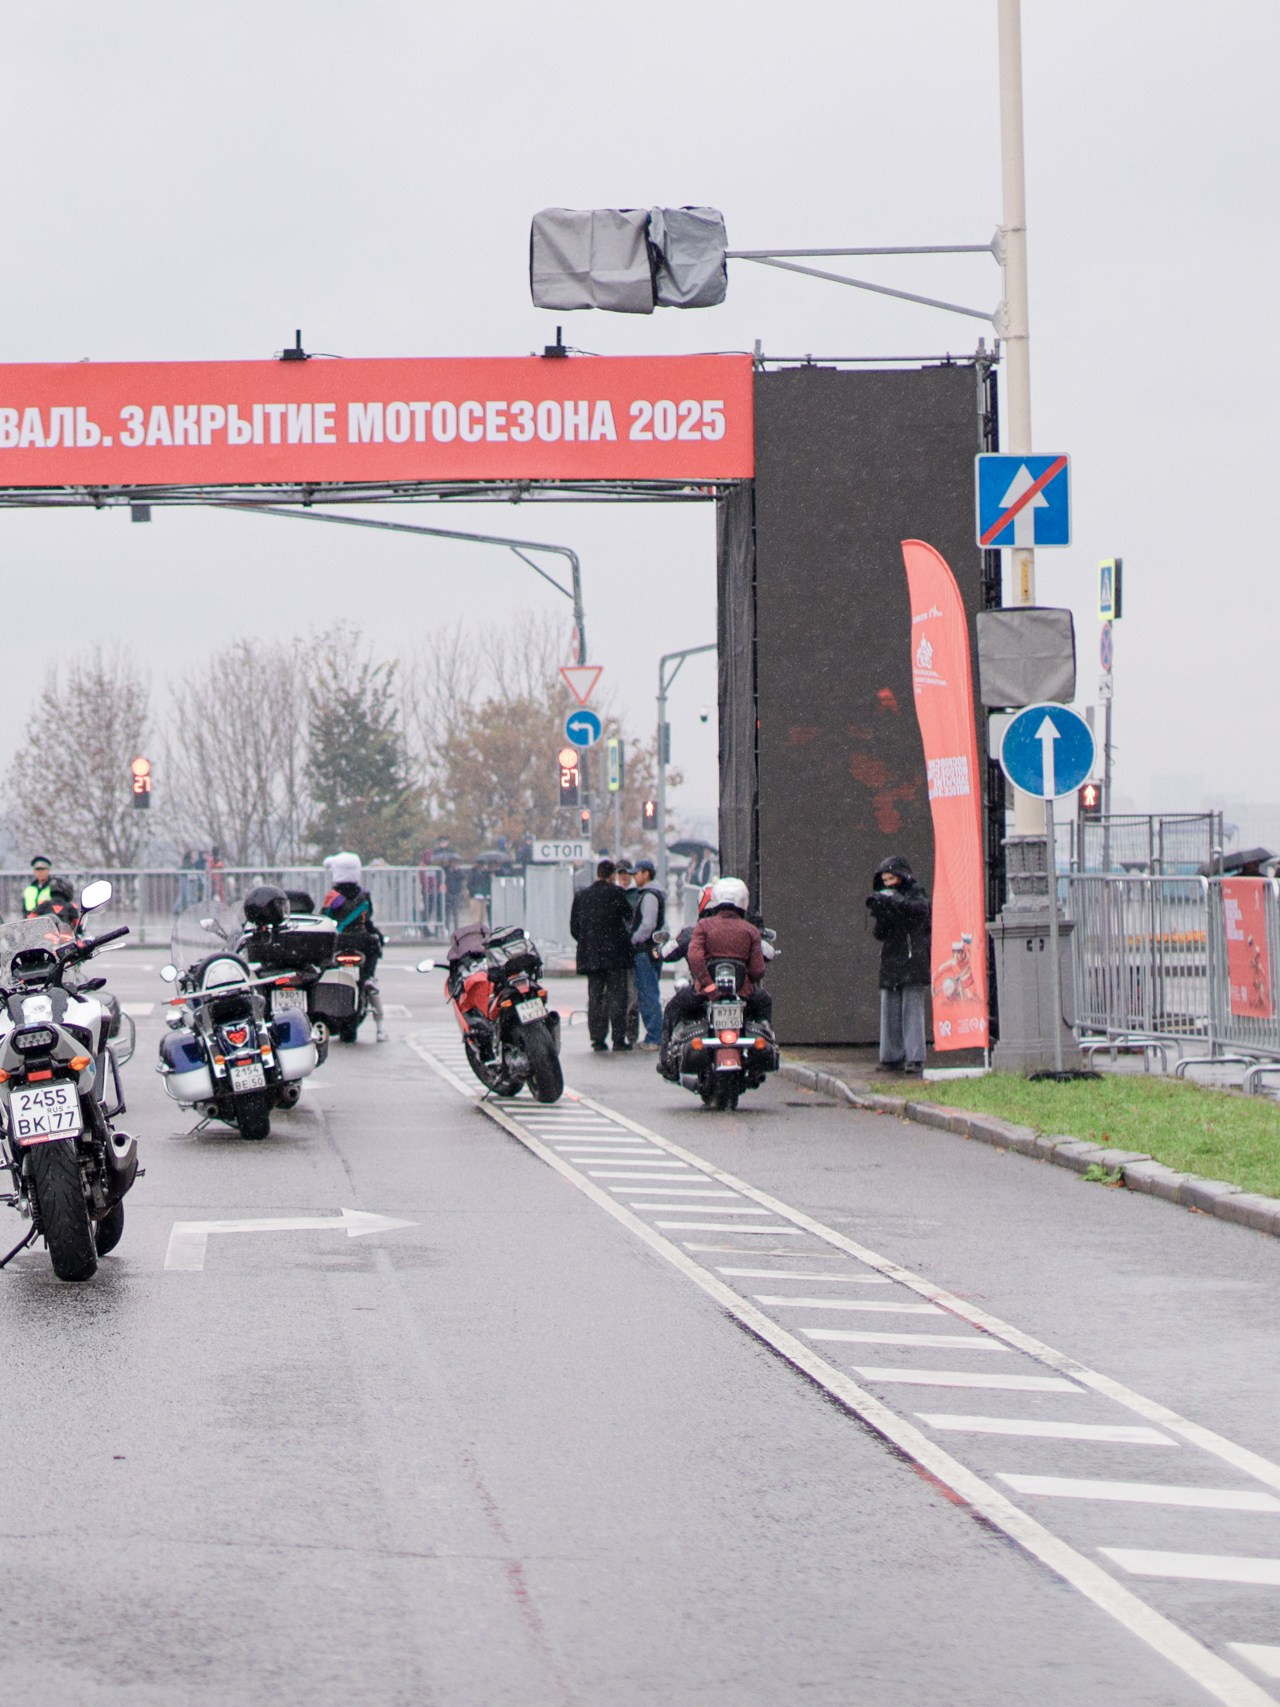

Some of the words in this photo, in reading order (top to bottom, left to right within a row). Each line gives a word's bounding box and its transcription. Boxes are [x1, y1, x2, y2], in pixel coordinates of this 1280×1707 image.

[120, 402, 337, 447] ЗАКРЫТИЕ
[348, 400, 618, 443] МОТОСЕЗОНА
[629, 400, 725, 441] 2025
[133, 776, 151, 793] 27
[561, 769, 579, 788] 27
[541, 844, 583, 858] СТОП
[235, 1066, 260, 1077] 2154
[251, 1077, 263, 1087] 50
[20, 1088, 67, 1111] 2455
[52, 1111, 75, 1129] 77
